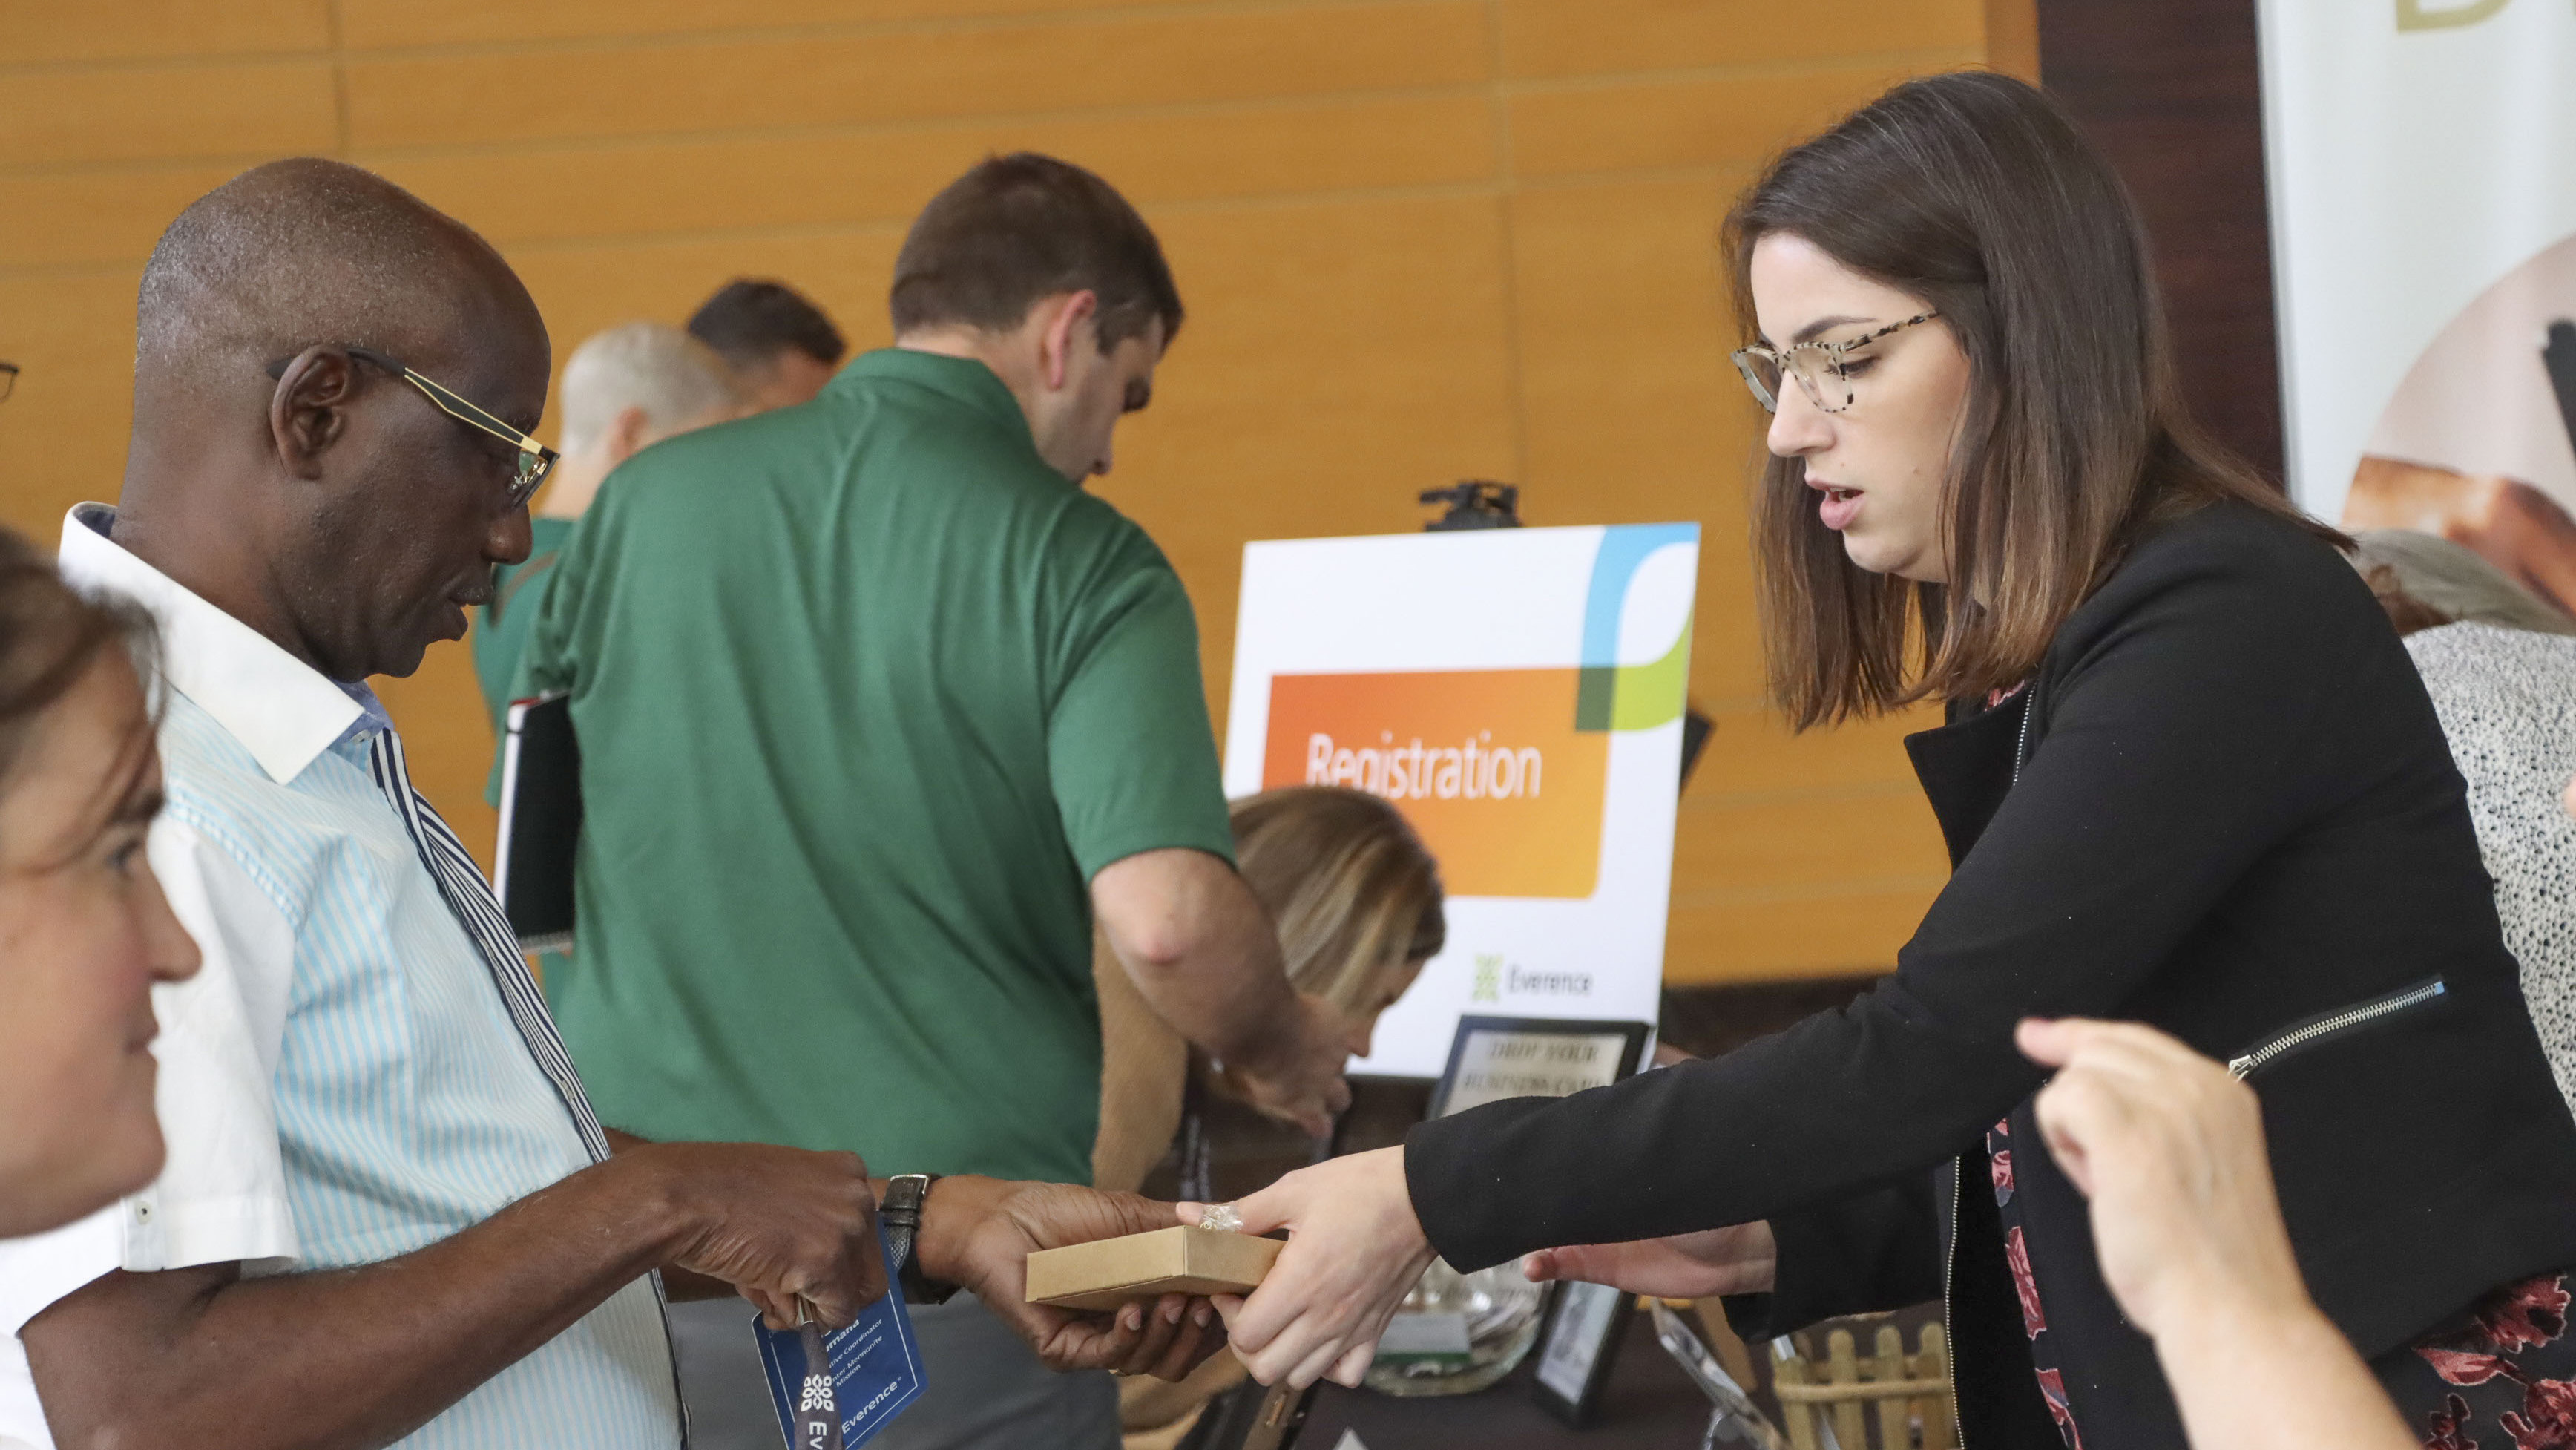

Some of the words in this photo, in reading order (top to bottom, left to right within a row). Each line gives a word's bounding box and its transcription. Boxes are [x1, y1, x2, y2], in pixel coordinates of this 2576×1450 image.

[1305, 729, 1542, 799] Registration
[1509, 965, 1592, 995] Everence
[844, 1319, 882, 1356] Coordinator
[832, 1336, 883, 1382] nter-Mennonite
[836, 1364, 861, 1388] Mission
[841, 1381, 898, 1434] Everence
